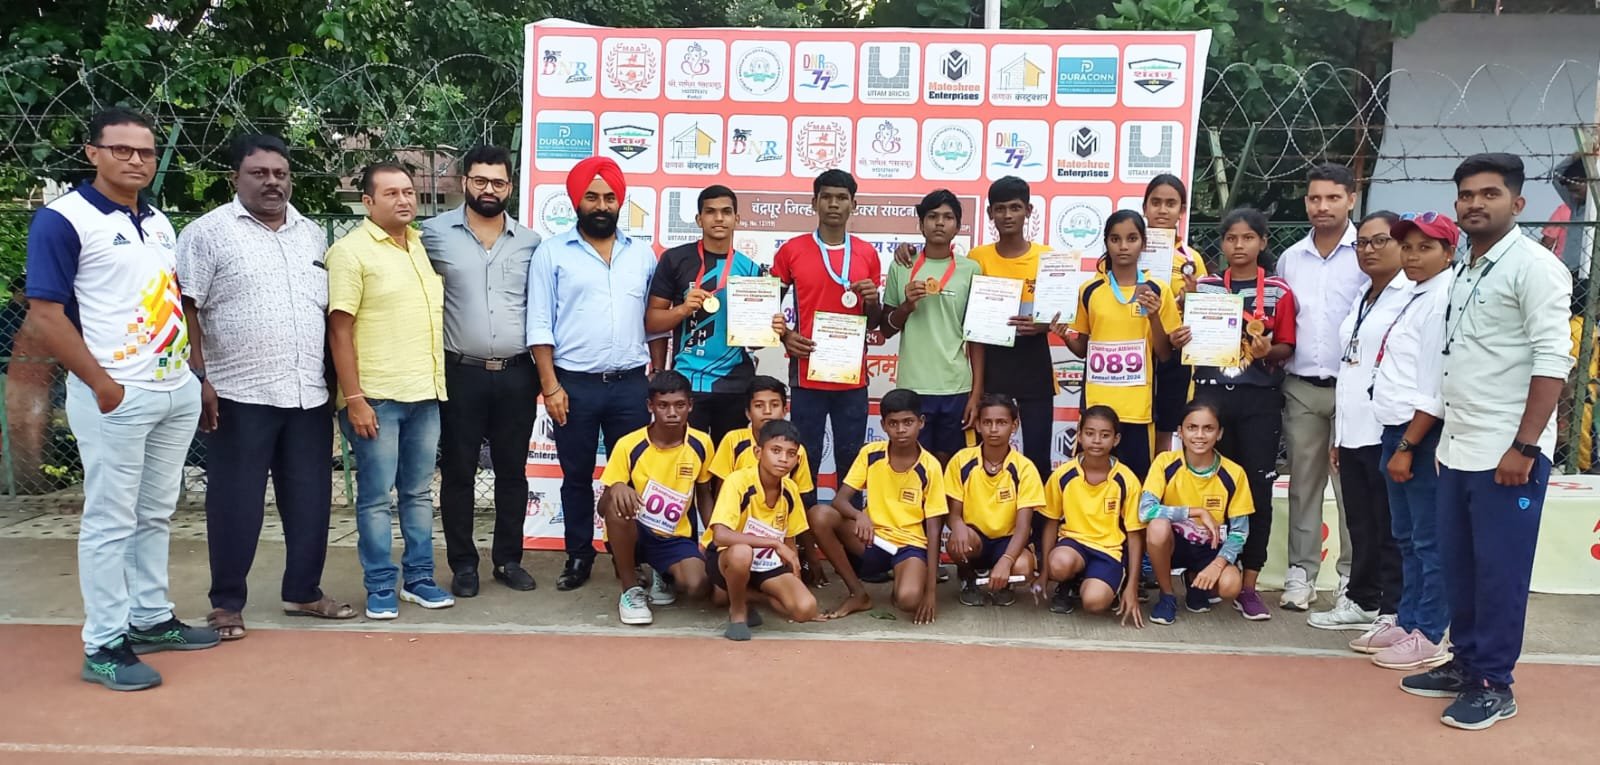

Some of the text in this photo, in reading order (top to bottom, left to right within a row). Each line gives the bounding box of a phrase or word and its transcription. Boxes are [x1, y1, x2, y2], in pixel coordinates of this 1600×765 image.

[1060, 73, 1114, 81] DURACONN
[928, 82, 981, 92] Matoshree
[928, 91, 980, 101] Enterprises
[539, 138, 591, 147] DURACONN
[996, 132, 1019, 147] DNR
[1005, 148, 1024, 169] 77
[1057, 159, 1111, 169] Matoshree
[1057, 168, 1109, 178] Enterprises
[752, 198, 781, 219] चंद्रपूर
[1090, 352, 1143, 374] 089
[528, 450, 559, 460] Enterp
[645, 494, 683, 523] 06
